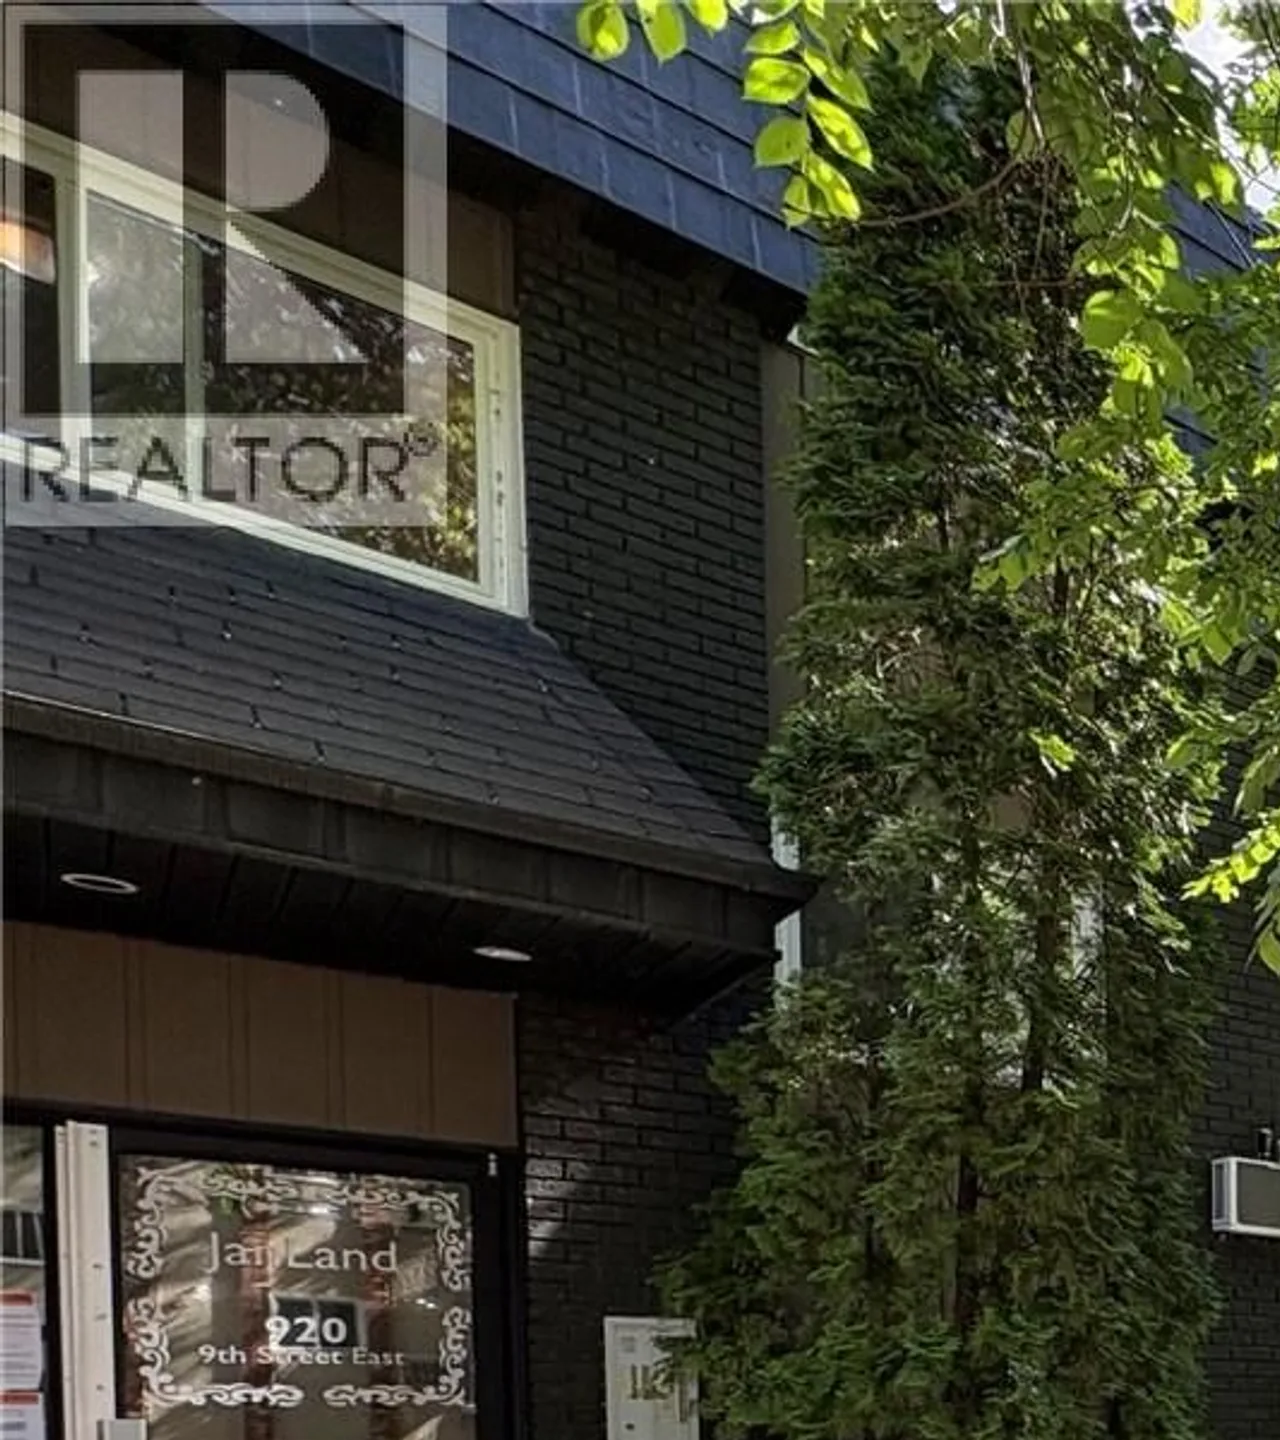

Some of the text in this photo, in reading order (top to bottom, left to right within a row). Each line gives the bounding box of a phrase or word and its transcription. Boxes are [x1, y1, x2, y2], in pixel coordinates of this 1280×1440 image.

[286, 1237, 398, 1271] Land
[265, 1315, 348, 1345] 920
[199, 1344, 405, 1366] 9th Street East
